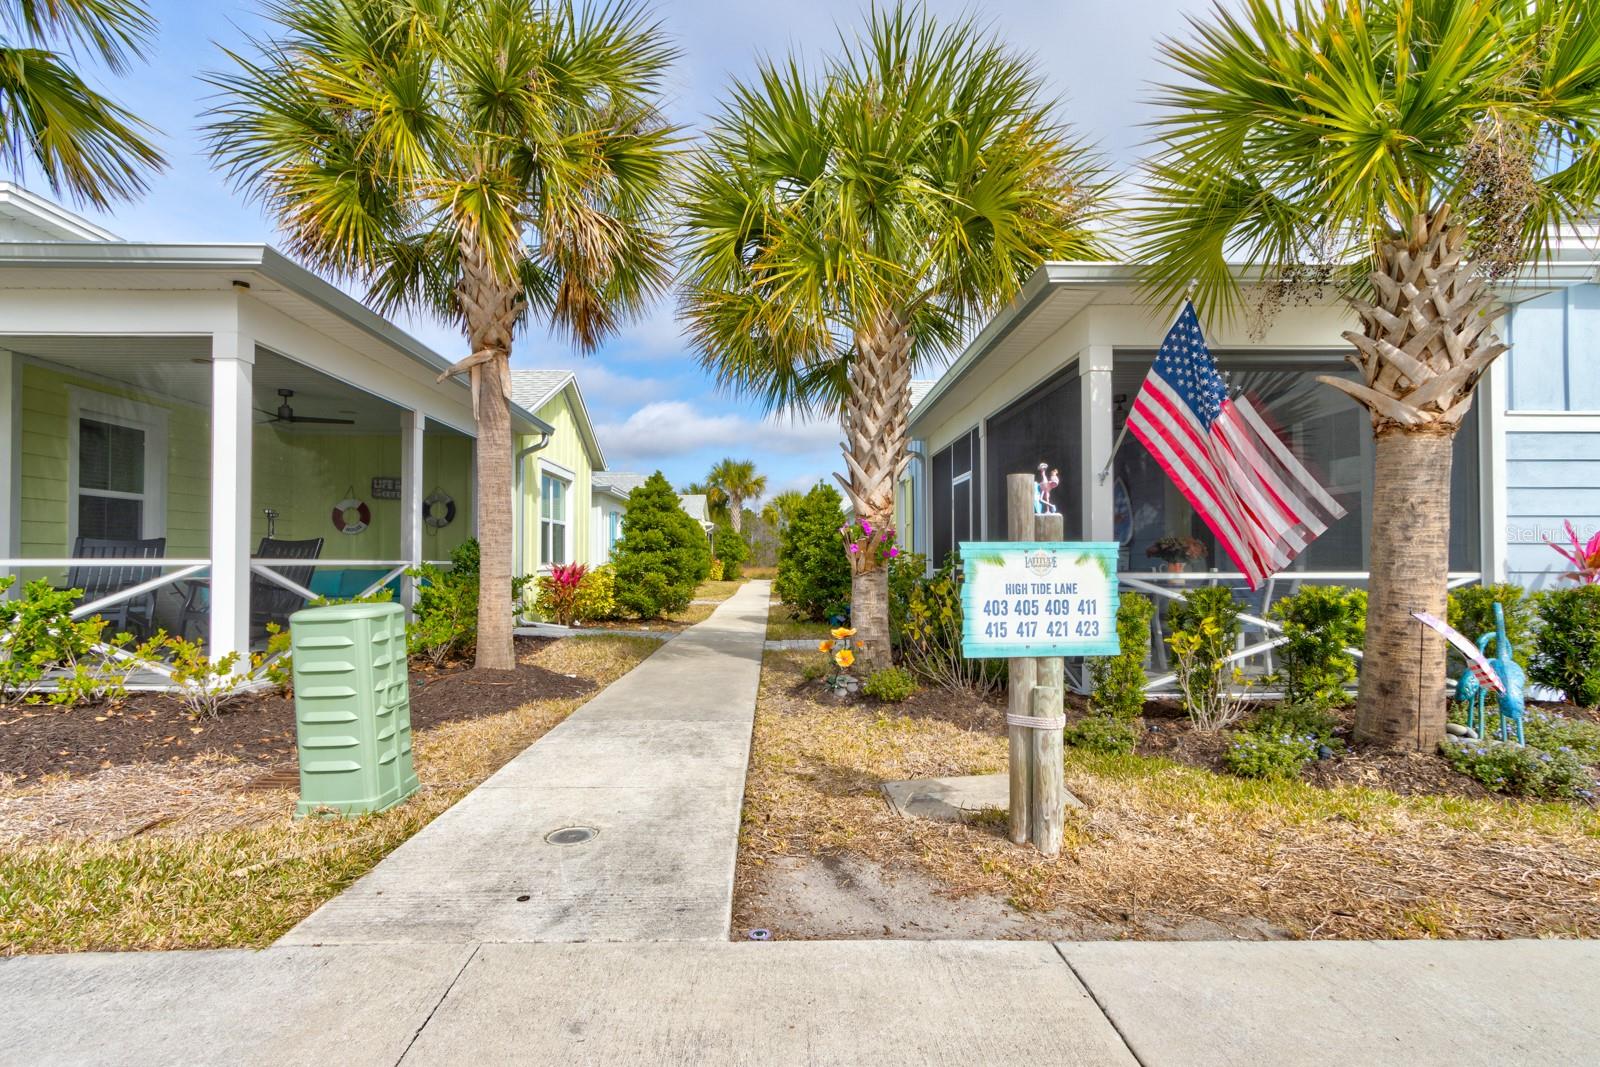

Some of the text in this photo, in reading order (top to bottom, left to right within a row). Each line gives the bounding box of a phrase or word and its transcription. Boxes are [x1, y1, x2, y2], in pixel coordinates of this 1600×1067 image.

[1005, 583, 1078, 595] HIGH TIDE LANE
[983, 599, 1097, 616] 403 405 409 411
[985, 620, 1099, 638] 415 417 421 423
